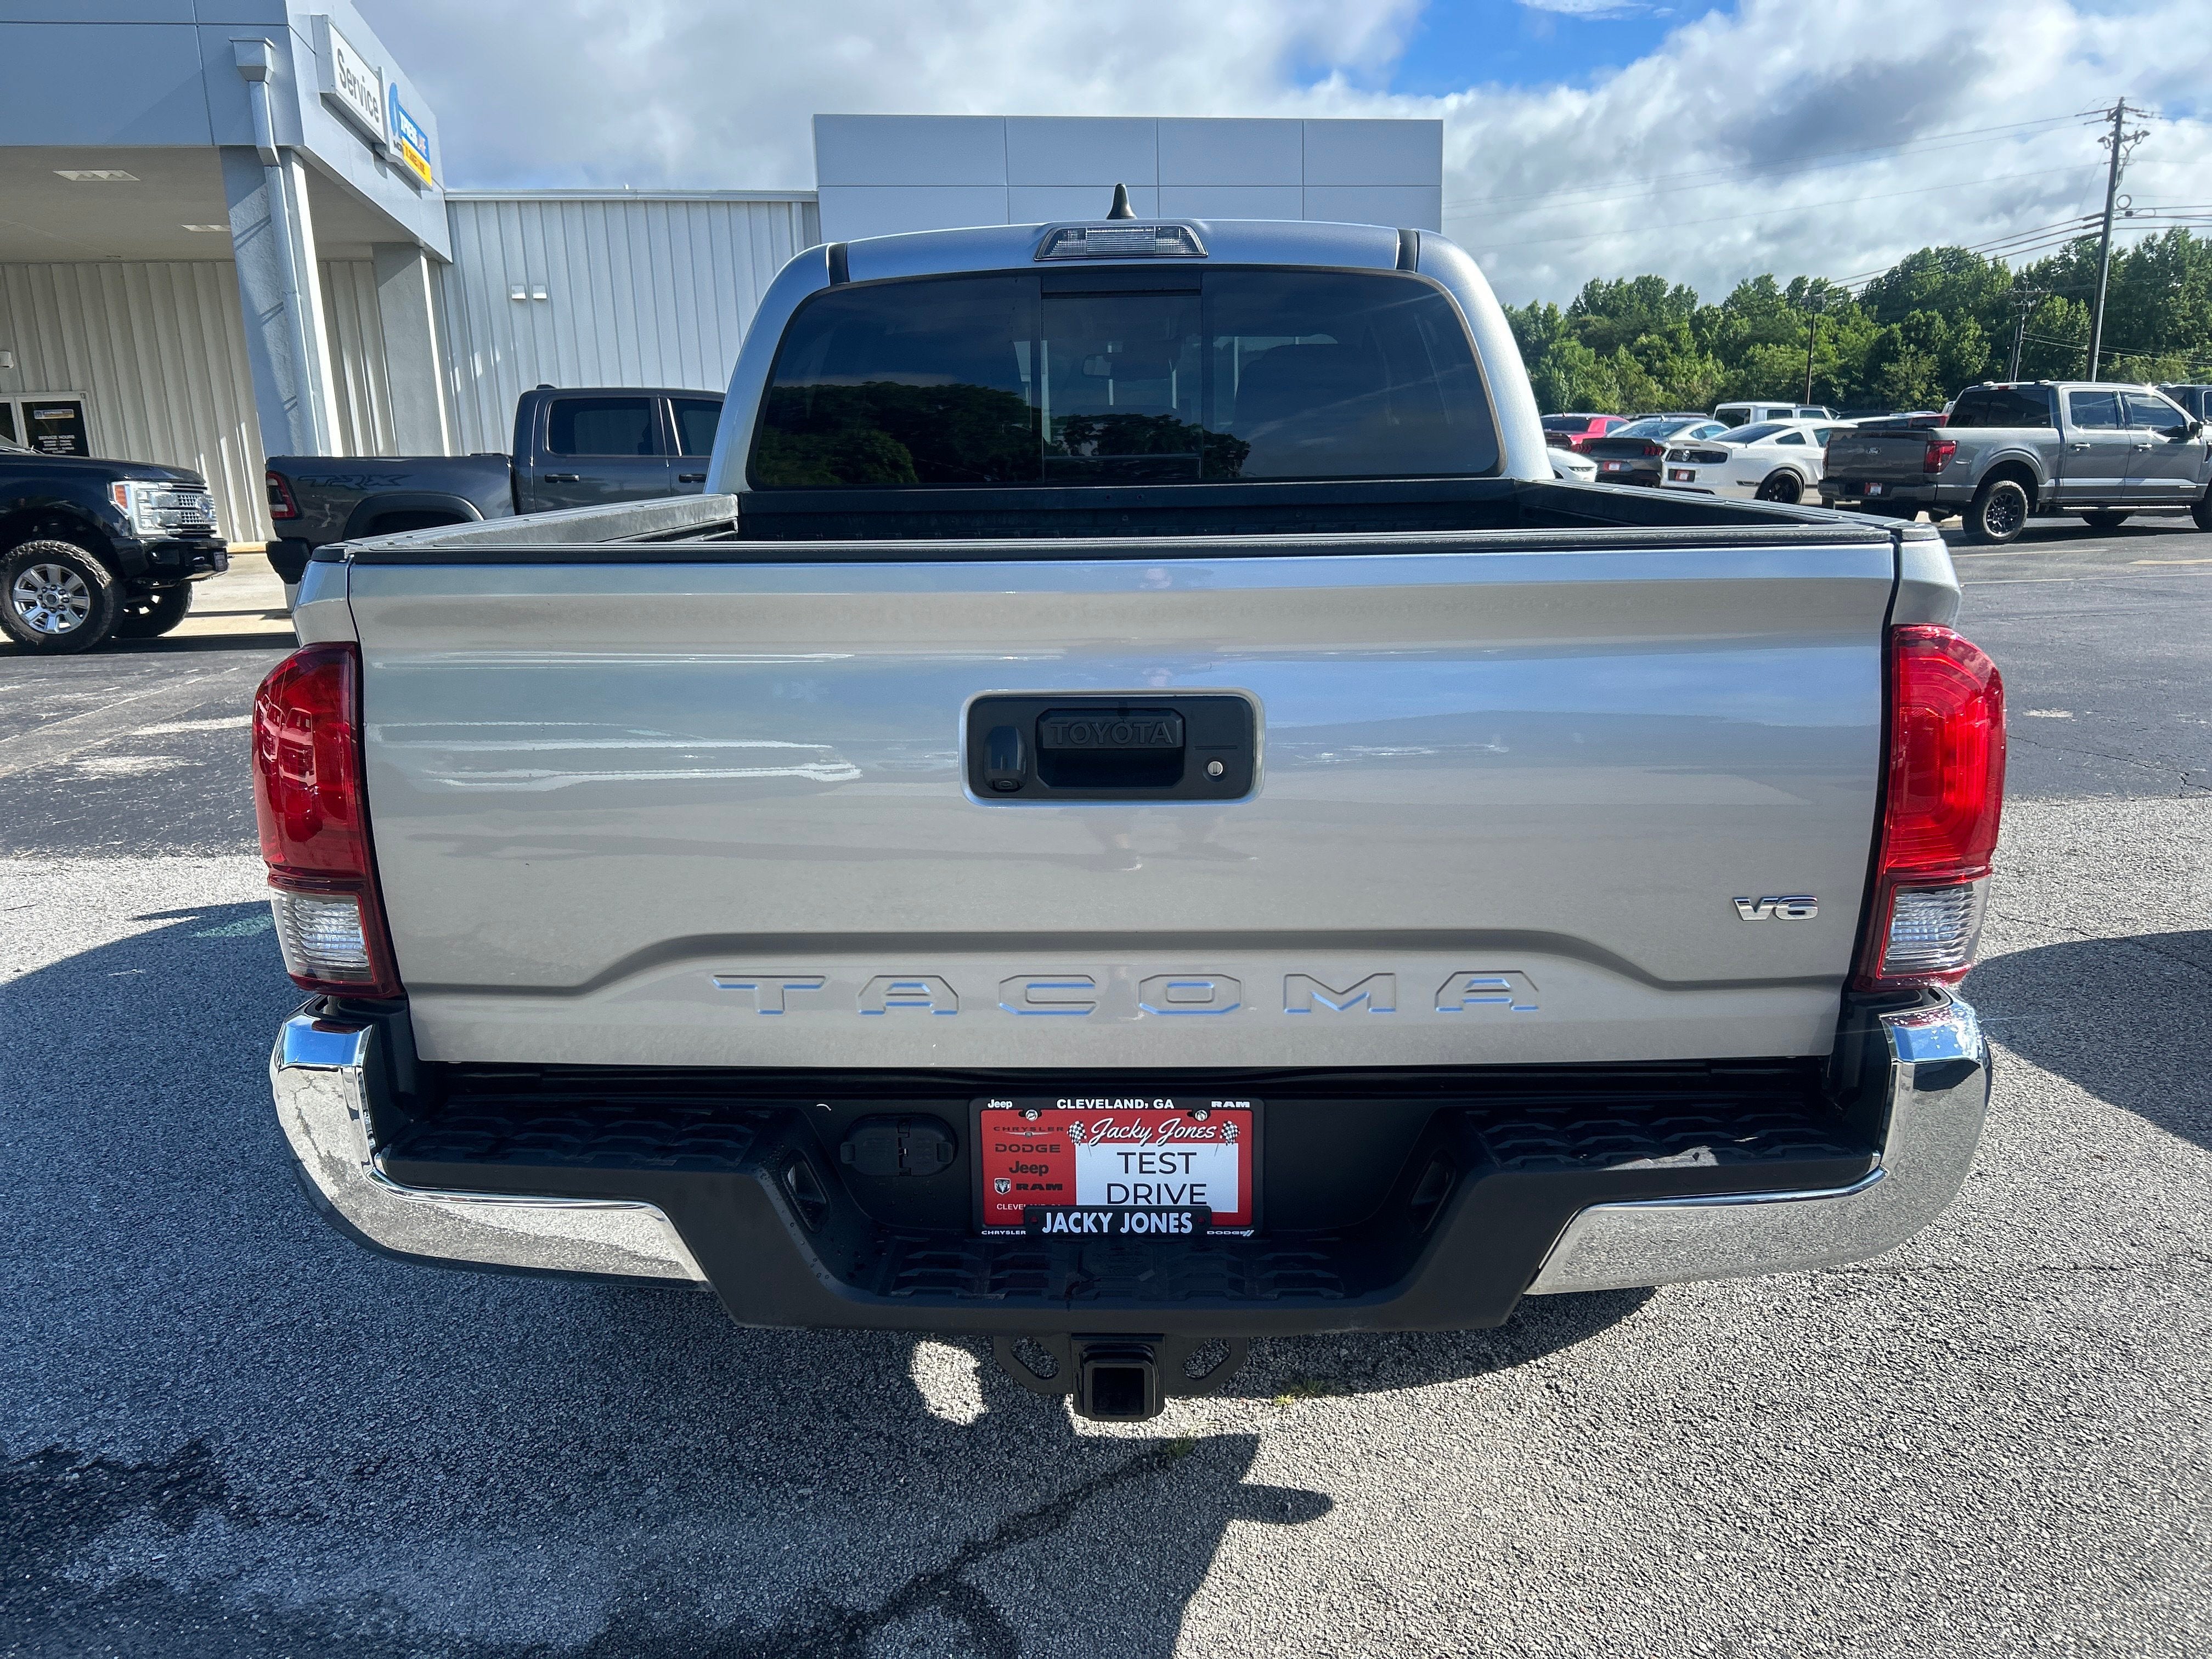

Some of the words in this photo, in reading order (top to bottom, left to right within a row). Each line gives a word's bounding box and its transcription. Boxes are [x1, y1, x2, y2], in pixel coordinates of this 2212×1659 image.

[337, 48, 380, 123] Service
[297, 474, 414, 490] TRX
[1049, 720, 1173, 745] TOYOTA
[1732, 895, 1819, 921] V6
[712, 969, 1540, 1017] TACOMA
[987, 1099, 1013, 1110] Jeep
[1056, 1098, 1149, 1109] CLEVELAND,
[1153, 1098, 1175, 1109] GA
[1088, 1117, 1153, 1147] Jacky
[1155, 1117, 1217, 1147] Jones
[995, 1143, 1062, 1153] DODGE
[1008, 1160, 1049, 1177] Jeep
[1116, 1152, 1198, 1175] TEST
[1015, 1183, 1063, 1191] RAM
[1107, 1183, 1207, 1205] DRIVE
[1041, 1212, 1114, 1234] JACKY
[1119, 1211, 1193, 1234] JONES
